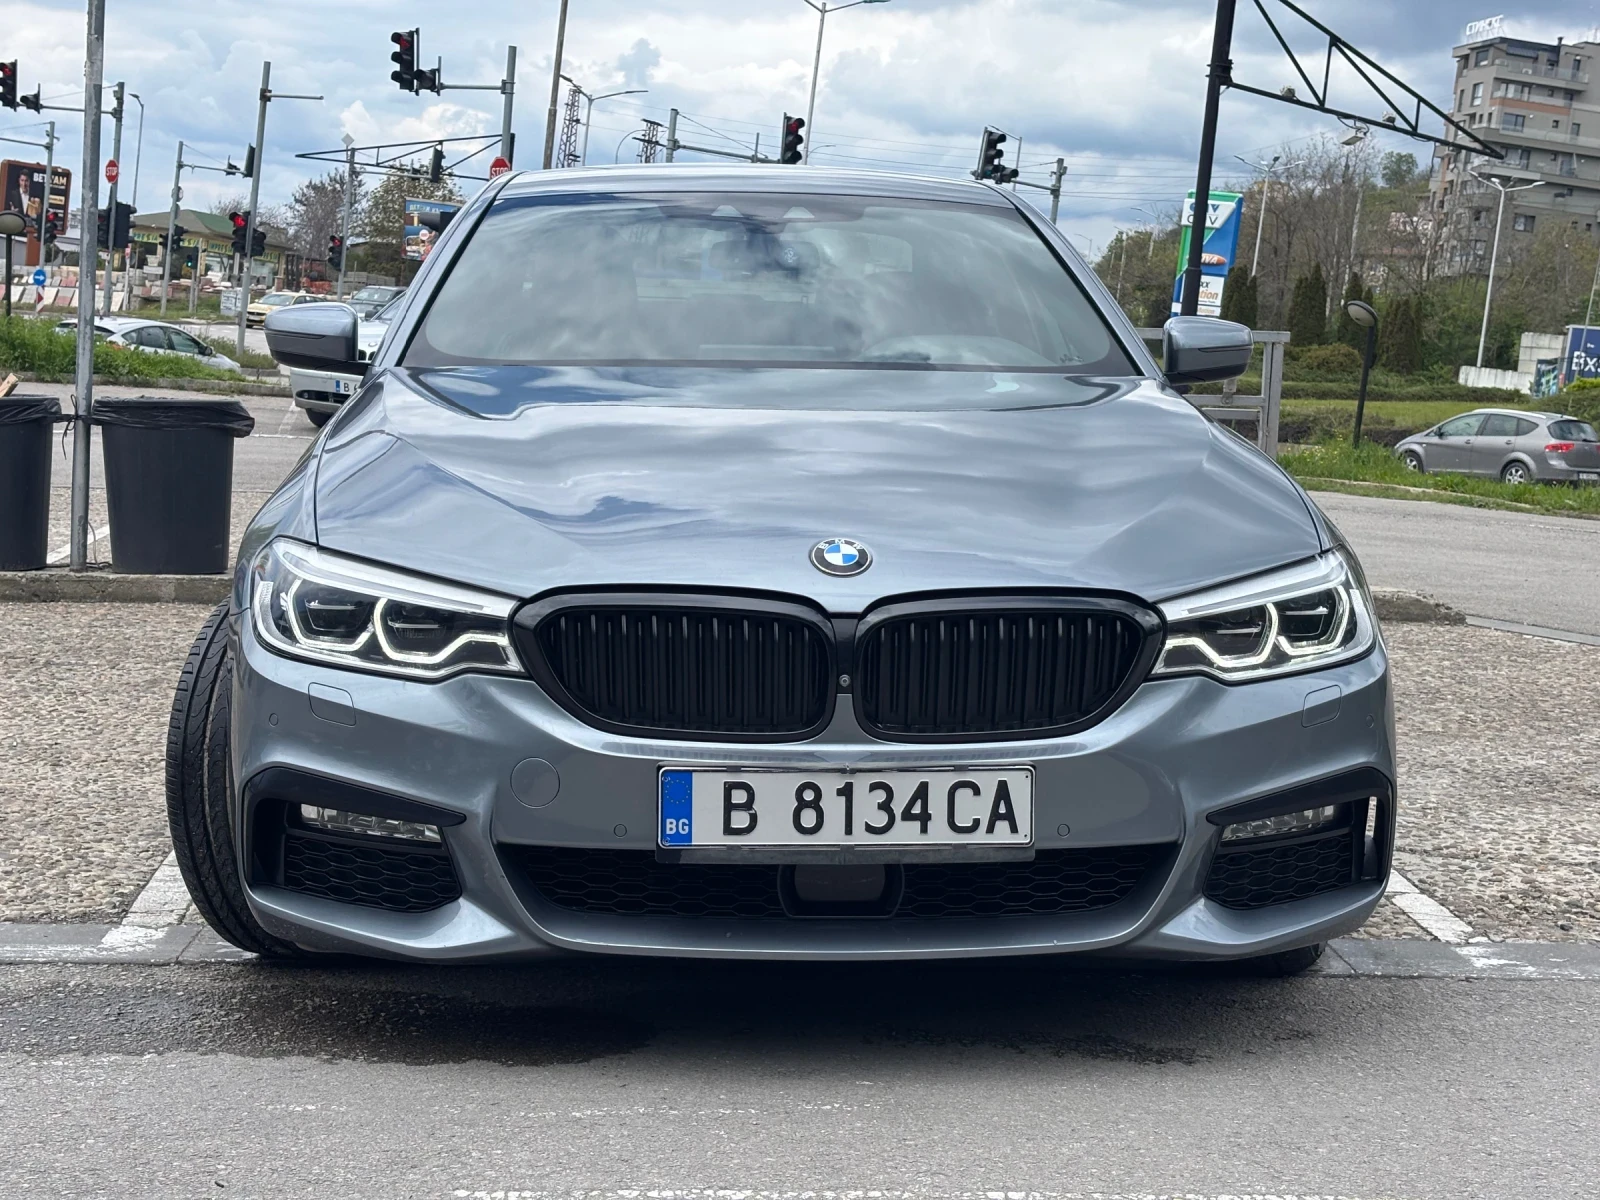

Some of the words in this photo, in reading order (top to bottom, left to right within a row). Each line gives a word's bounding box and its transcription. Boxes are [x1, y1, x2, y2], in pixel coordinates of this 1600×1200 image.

[106, 166, 118, 176] STOP
[818, 538, 865, 550] BMW
[723, 780, 758, 836] B
[665, 818, 689, 835] BG
